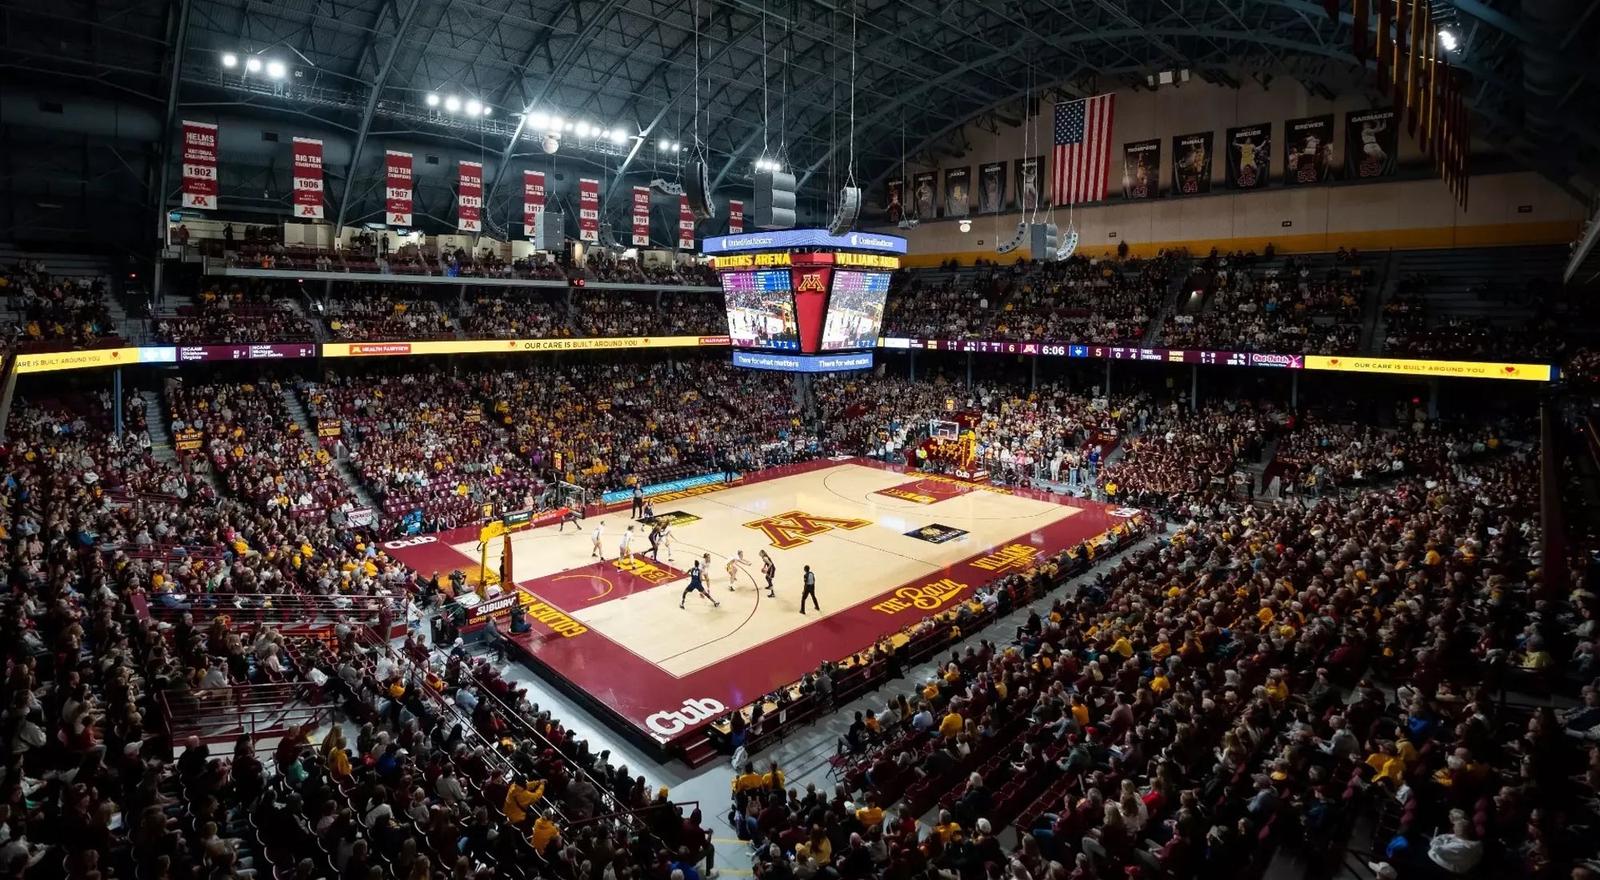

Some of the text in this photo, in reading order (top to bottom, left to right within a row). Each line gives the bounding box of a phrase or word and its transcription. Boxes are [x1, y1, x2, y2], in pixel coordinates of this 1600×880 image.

[186, 132, 214, 143] HELMS
[295, 154, 322, 163] BIG TEN
[189, 167, 211, 177] 1902
[388, 166, 411, 175] BIG TEN
[299, 180, 319, 189] 1906
[391, 190, 408, 198] 1907
[755, 252, 791, 266] ARENA
[836, 253, 878, 266] WILLIAMS
[798, 274, 824, 291] M
[1009, 344, 1015, 352] 6
[1042, 345, 1065, 355] 6:06
[1095, 348, 1102, 356] 5
[742, 511, 873, 550] M
[384, 536, 437, 549] Cub
[871, 578, 968, 614] THE Barn
[476, 596, 516, 616] SUBWAY
[646, 698, 725, 735] Cub
